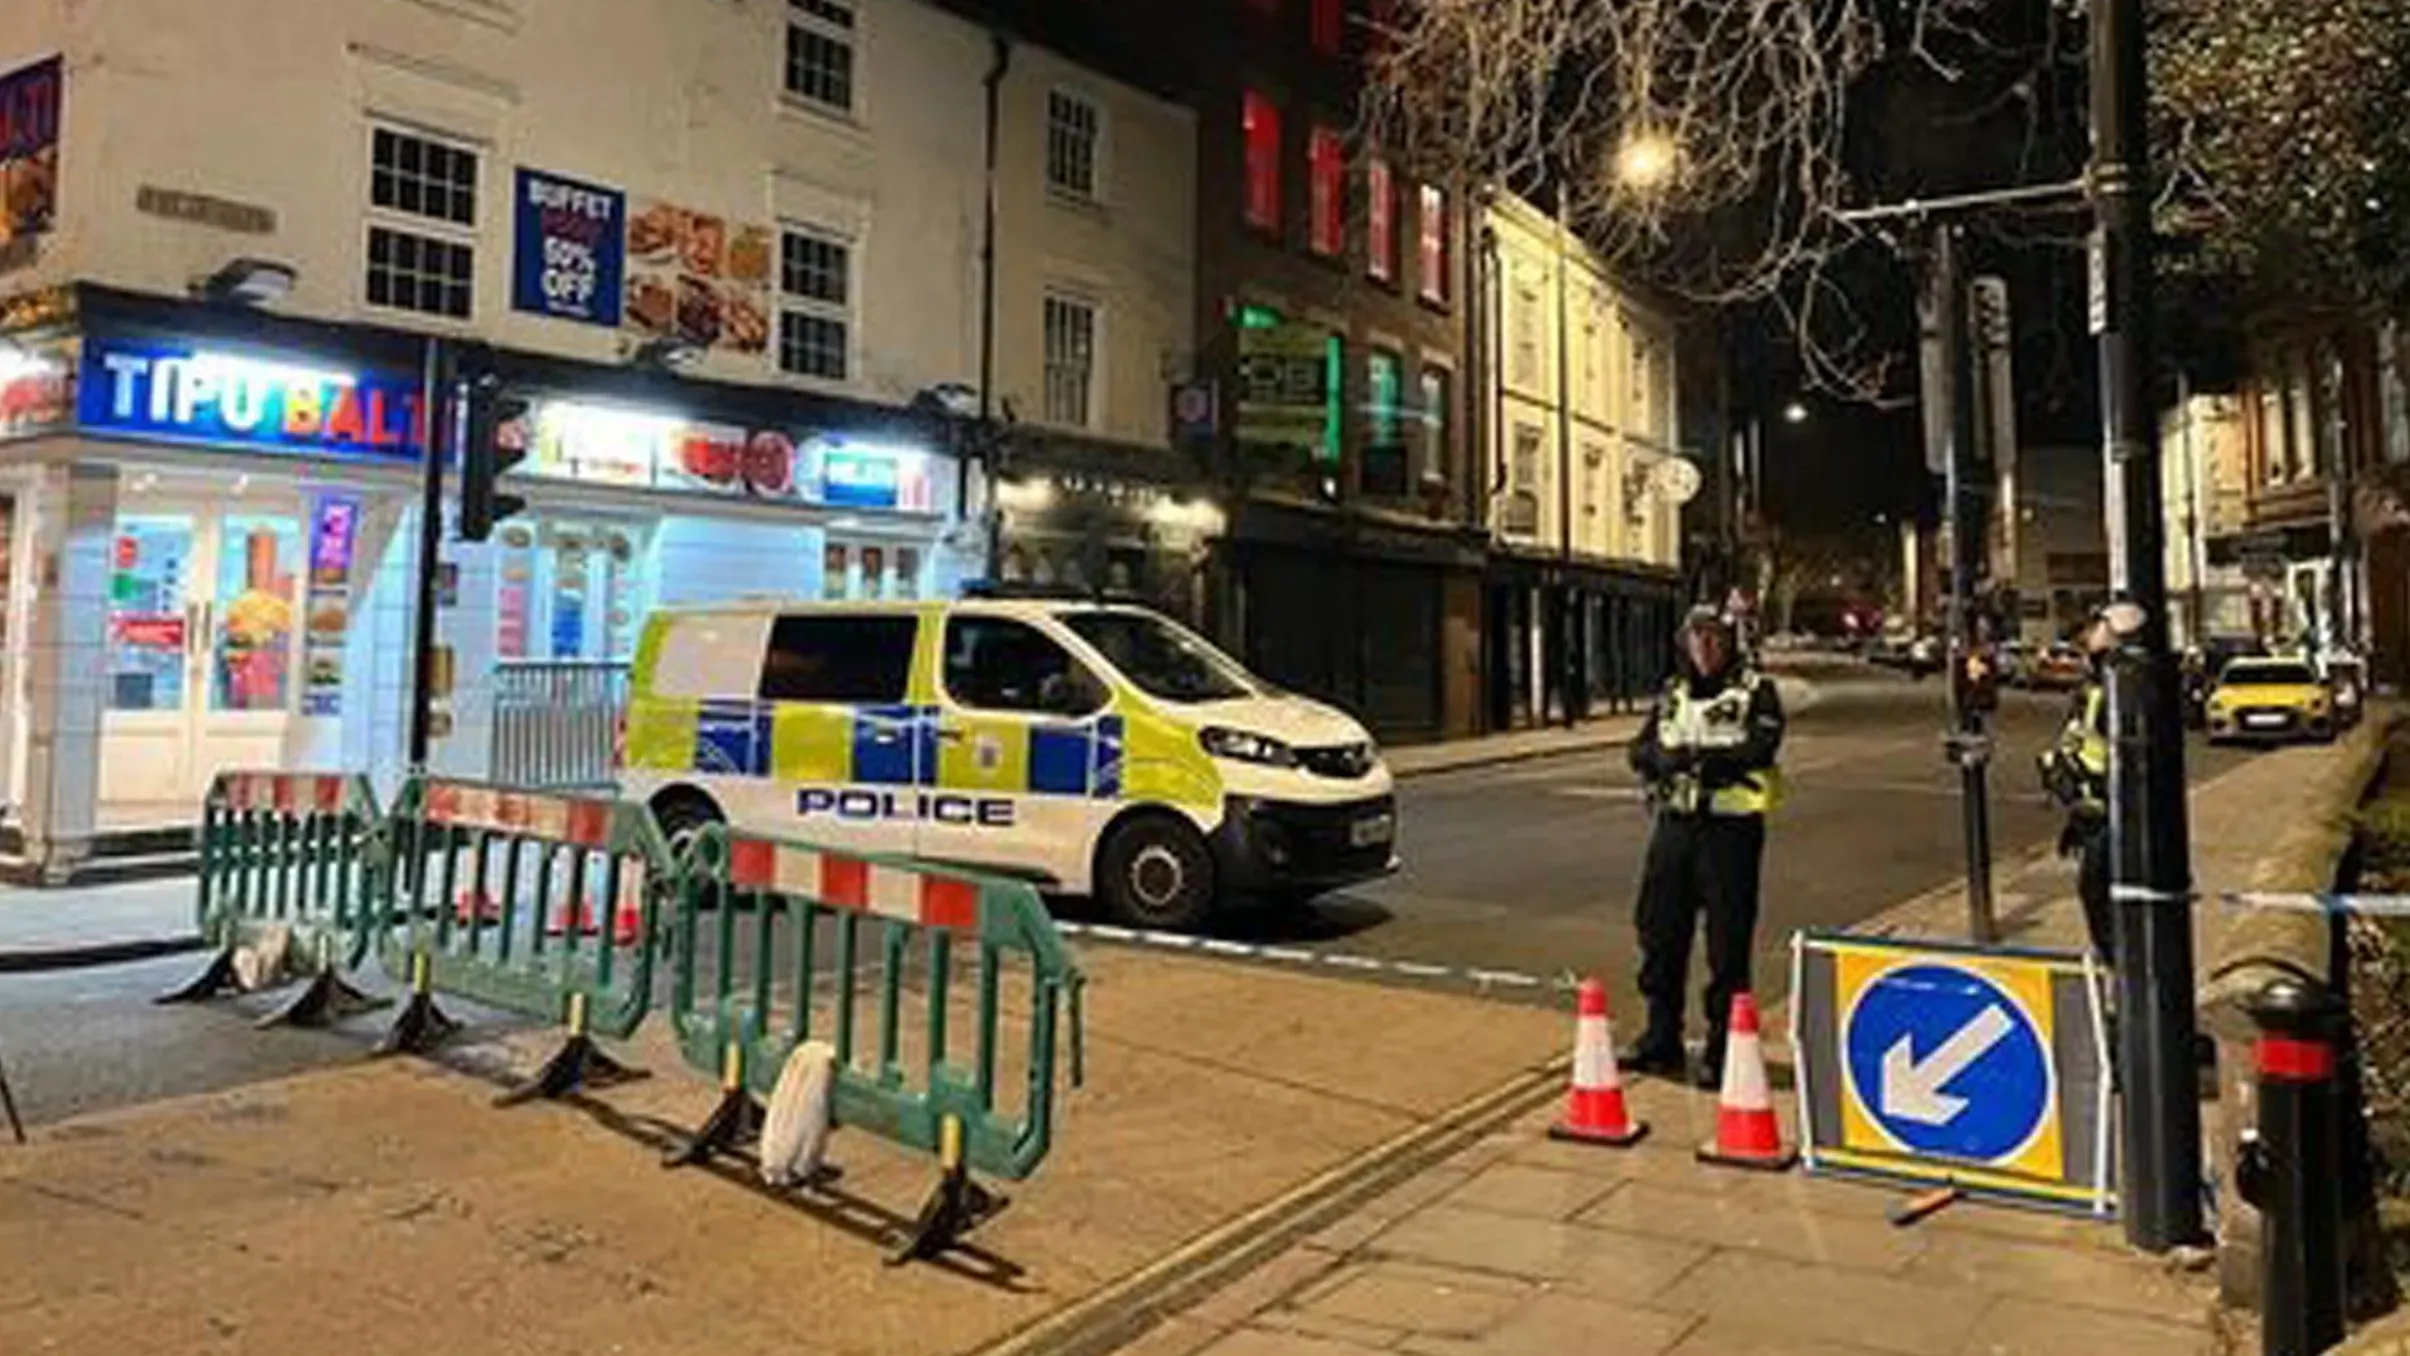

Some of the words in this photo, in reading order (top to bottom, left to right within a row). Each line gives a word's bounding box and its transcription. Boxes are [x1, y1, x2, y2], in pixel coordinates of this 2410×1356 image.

[529, 179, 612, 219] BUFFET
[541, 267, 596, 303] OFF
[104, 353, 264, 430] TIPU
[797, 788, 1015, 827] POLICE
